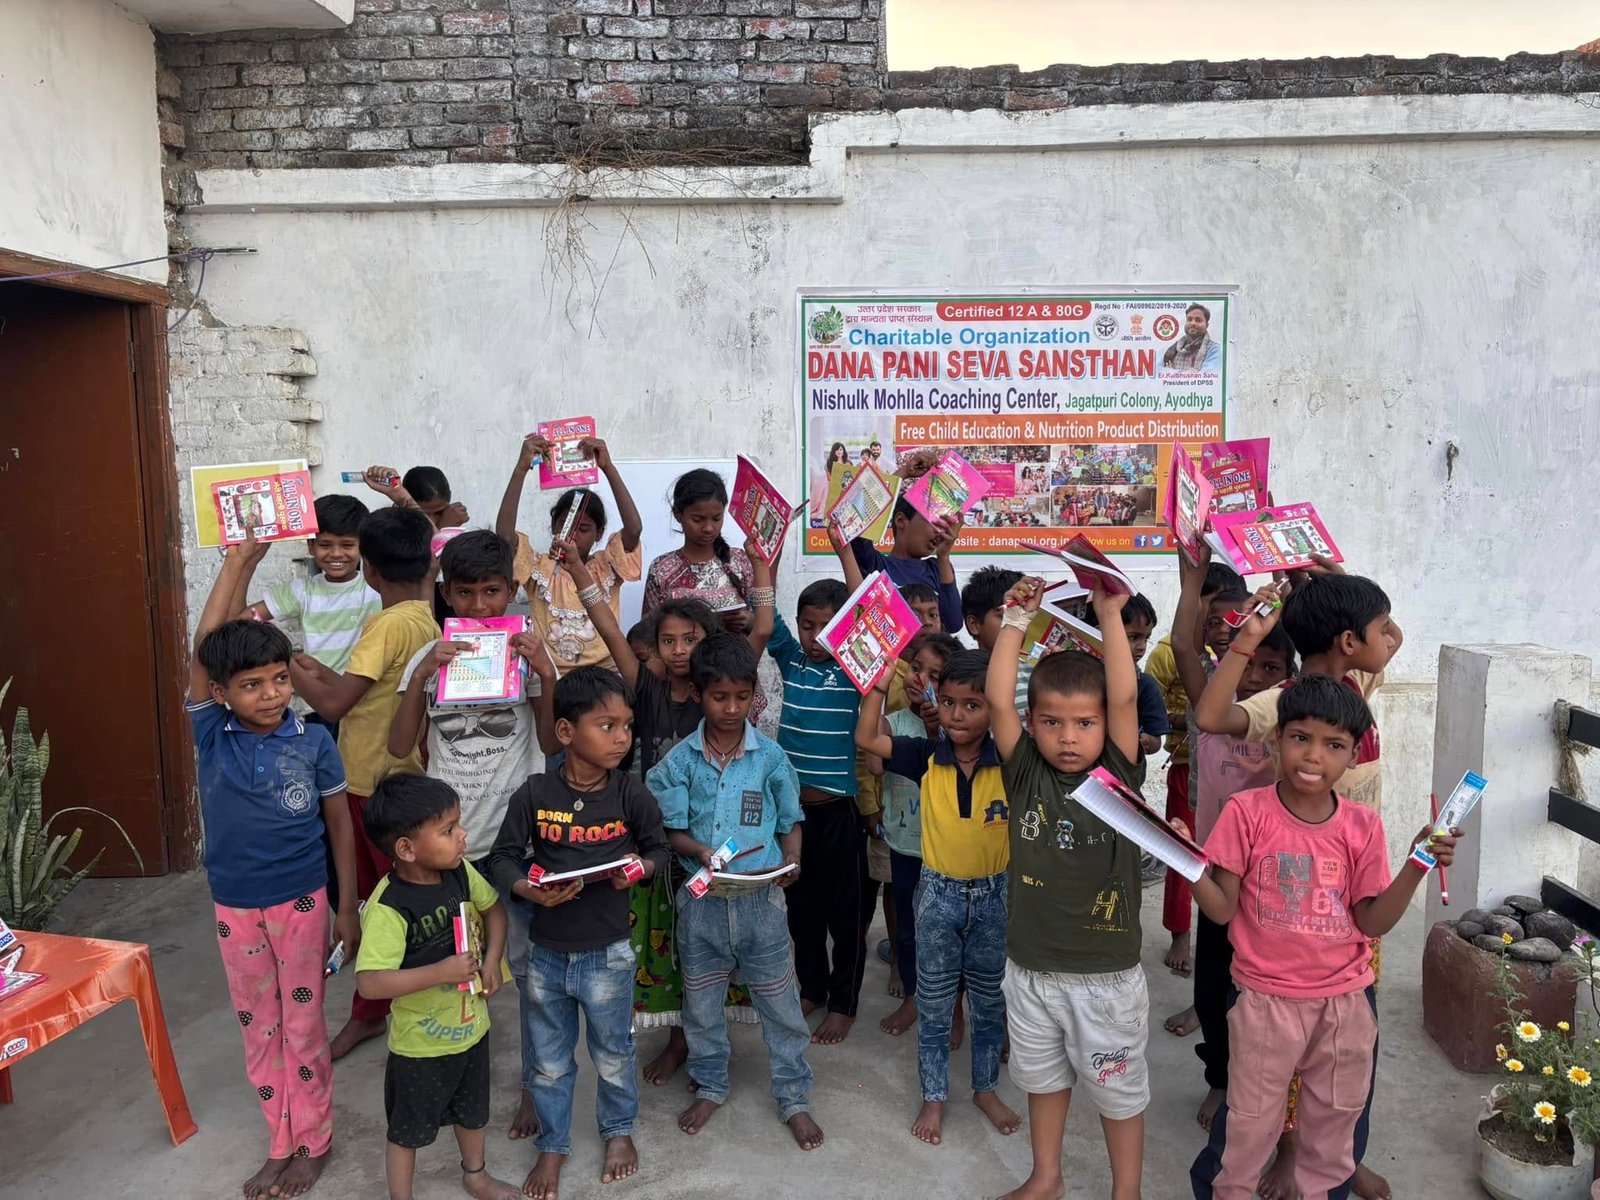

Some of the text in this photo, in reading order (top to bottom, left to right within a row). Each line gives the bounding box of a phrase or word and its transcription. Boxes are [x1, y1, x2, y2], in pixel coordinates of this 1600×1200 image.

[944, 304, 1084, 318] Certified 12 A & 80G
[1095, 303, 1111, 311] Regd
[849, 327, 1090, 348] Charitable Organization
[808, 349, 1156, 380] DANA PANI SEVA SANSTHAN
[812, 386, 1213, 414] Nishulk Mohlla Coaching Center, Jagatpuri Colony, Ayodhya
[901, 419, 1219, 440] Free Child Education & Nutrition Product Distribution
[1223, 474, 1233, 486] IN
[1233, 471, 1251, 483] ONE
[282, 479, 304, 531] ALL IN ONE
[1106, 538, 1117, 546] us
[1119, 538, 1131, 546] on
[869, 607, 901, 649] ALL IN ONE
[537, 809, 574, 823] BORN
[537, 820, 628, 843] TO ROCK
[1277, 851, 1314, 882] N
[1277, 884, 1313, 913] Y
[418, 1017, 475, 1041] SUPER
